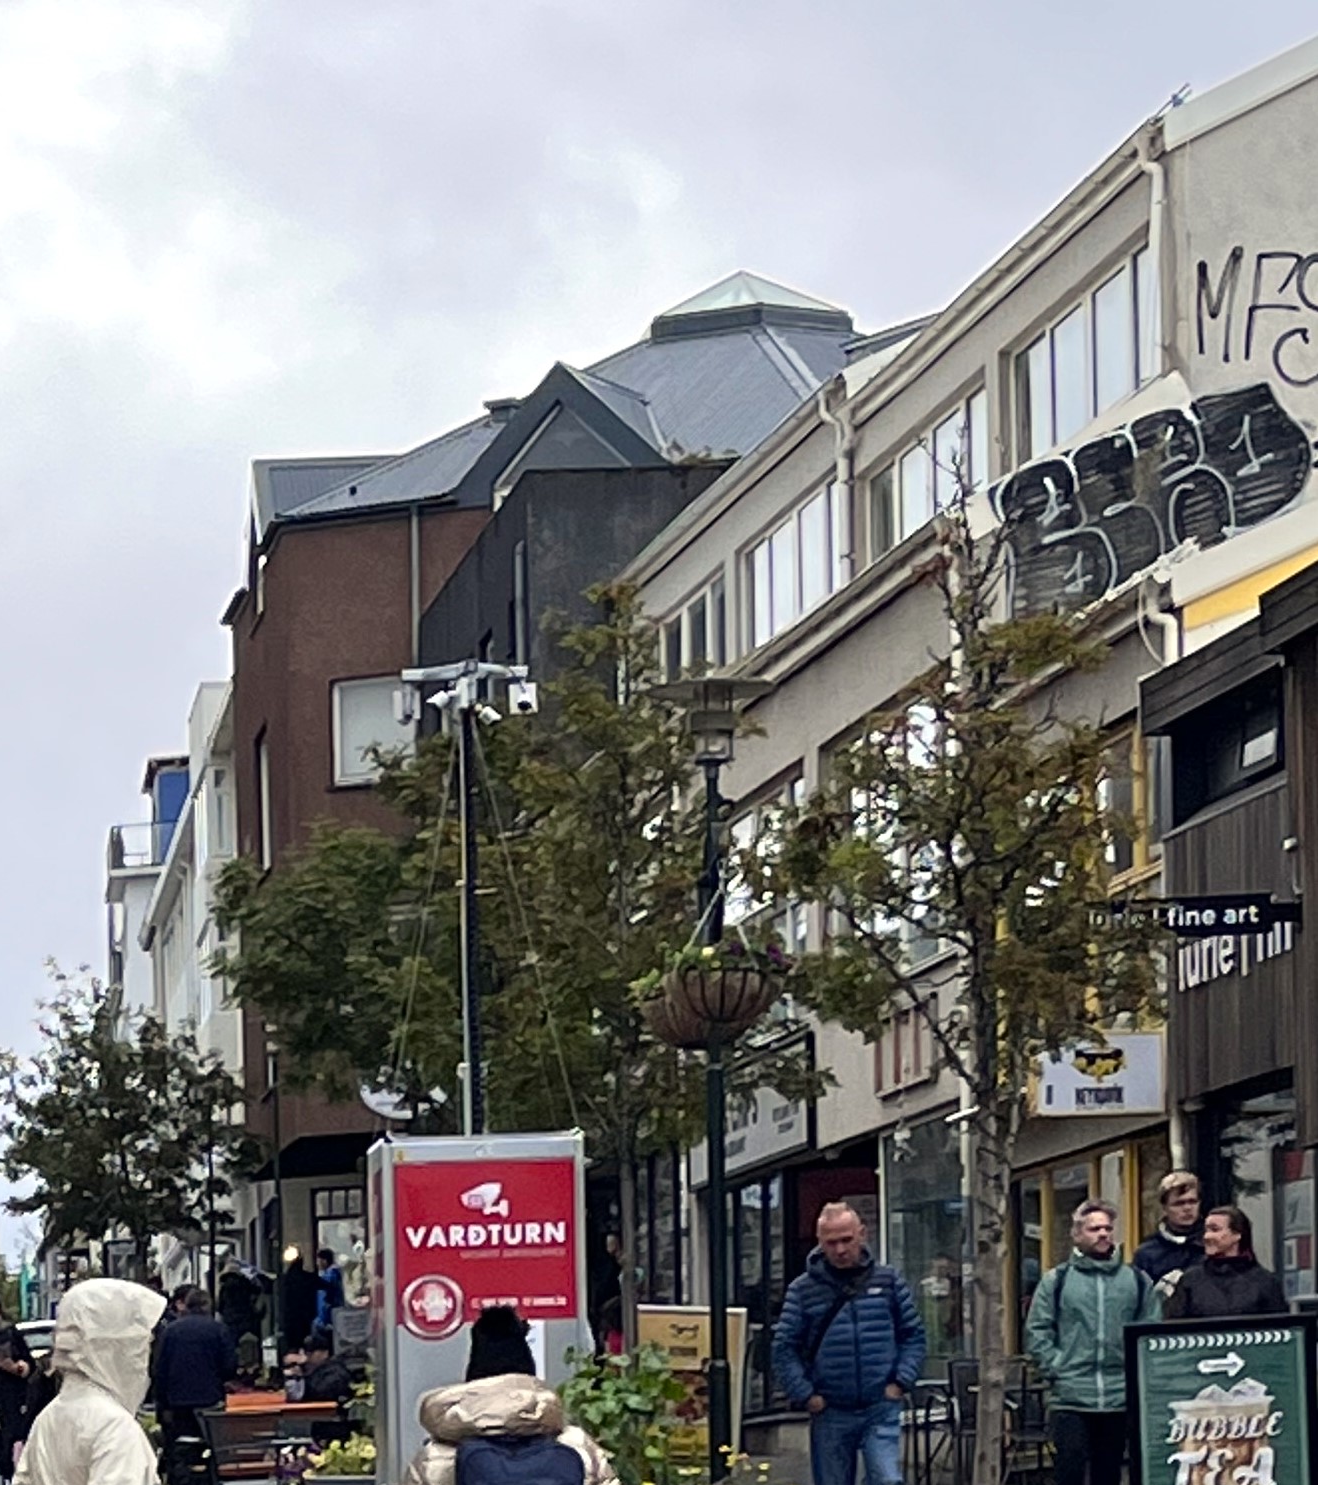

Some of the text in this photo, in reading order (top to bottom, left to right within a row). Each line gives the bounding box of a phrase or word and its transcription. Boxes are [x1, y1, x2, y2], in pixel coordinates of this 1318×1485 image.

[1167, 905, 1217, 927] fine
[1223, 905, 1259, 924] art
[404, 1221, 567, 1249] VARÐTURN
[1165, 1410, 1284, 1445] BUBBLE
